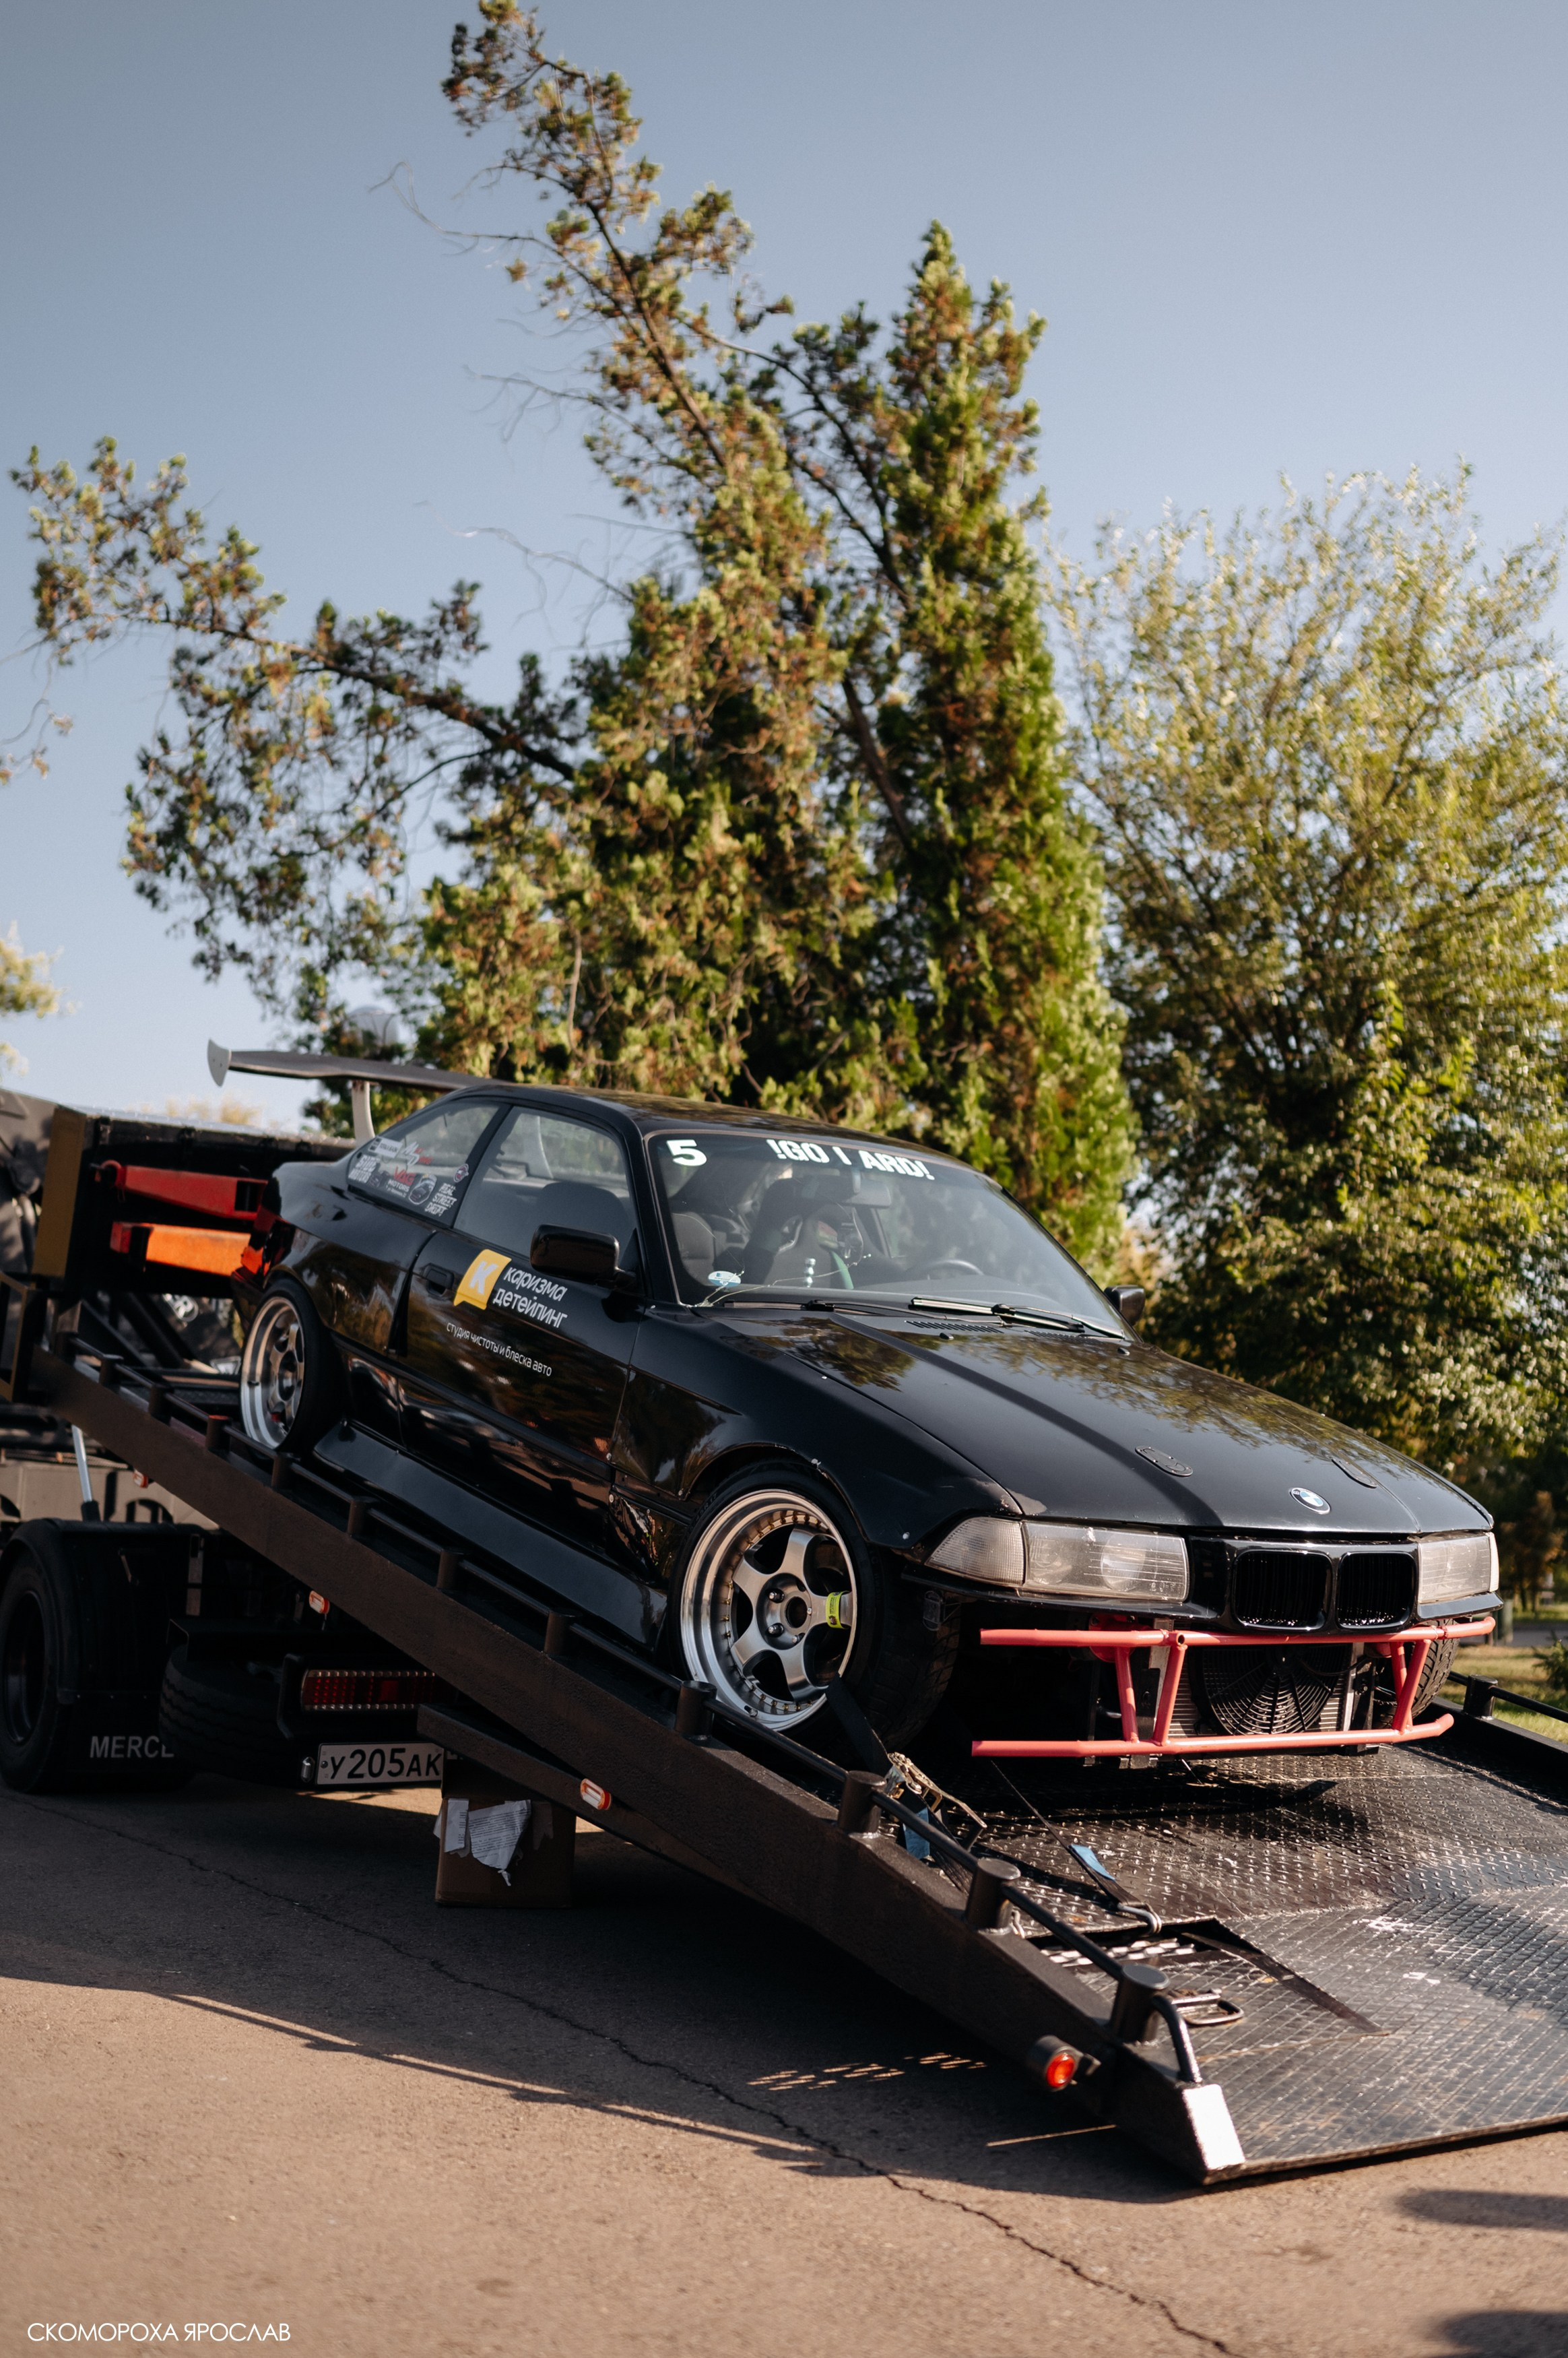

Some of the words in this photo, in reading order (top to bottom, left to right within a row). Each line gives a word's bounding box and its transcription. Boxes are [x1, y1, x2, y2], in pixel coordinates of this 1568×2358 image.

[666, 1139, 707, 1166] 5
[387, 1180, 410, 1192] MOTORS
[393, 1166, 416, 1186] VAG
[432, 1192, 457, 1208] STREET
[504, 1267, 568, 1302] каризма
[492, 1288, 568, 1328] детейлинг
[446, 1323, 469, 1340] студия
[470, 1333, 499, 1353] чистоты
[499, 1346, 505, 1356] и
[505, 1345, 532, 1368] блеска
[532, 1360, 552, 1376] авто
